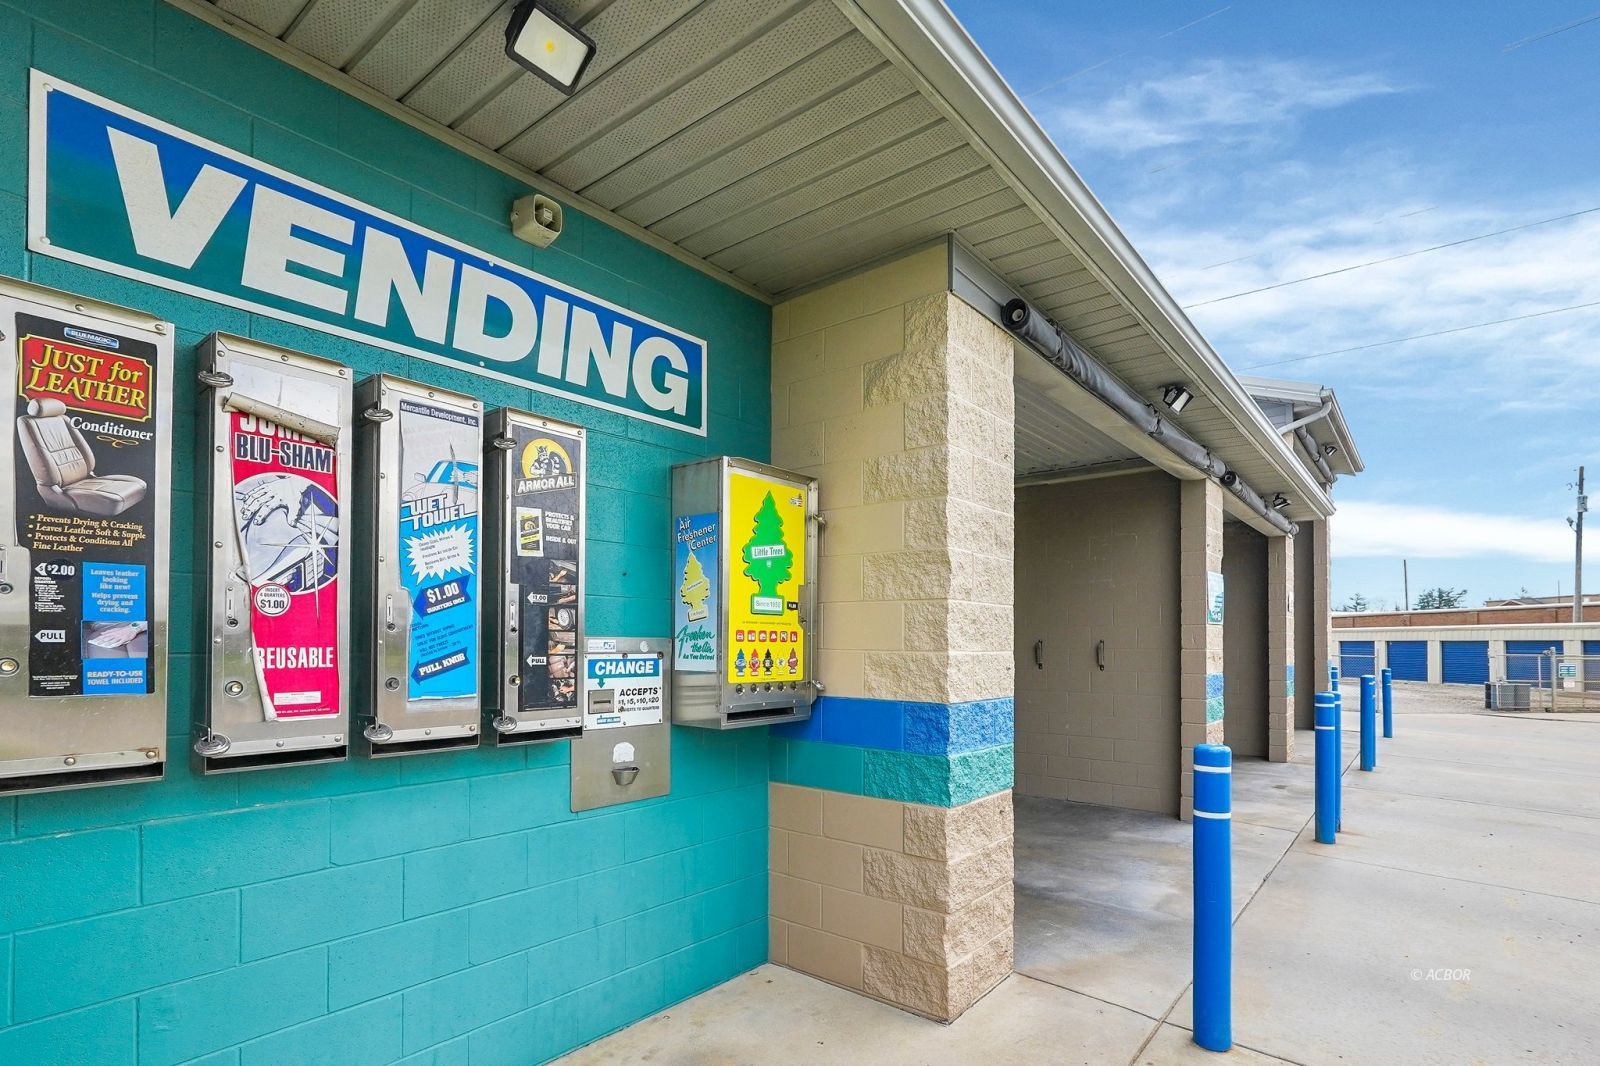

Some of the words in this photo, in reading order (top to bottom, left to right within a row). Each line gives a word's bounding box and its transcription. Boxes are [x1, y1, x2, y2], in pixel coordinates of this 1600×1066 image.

[106, 126, 689, 417] VENDING
[32, 344, 103, 377] JUST
[106, 361, 143, 383] for
[26, 366, 146, 410] LEATHER
[401, 402, 430, 415] Mercantile
[431, 408, 467, 424] Development,
[468, 417, 477, 426] Inc.
[70, 416, 153, 441] Conditioner
[235, 432, 332, 474] BLU-SHAM
[518, 478, 557, 494] ARMOR
[557, 476, 575, 487] ALL
[405, 493, 447, 516] WET
[37, 514, 71, 524] Prevents
[72, 517, 100, 529] Drying
[101, 520, 108, 528] &
[110, 520, 143, 532] Cracking
[405, 504, 468, 531] TOWEL
[679, 518, 691, 530] Air
[34, 532, 68, 542] Protects
[78, 536, 120, 546] Conditions
[36, 523, 62, 532] Leaves
[64, 526, 94, 535] Leather
[95, 528, 111, 536] Soft
[122, 530, 146, 540] Supple
[677, 524, 716, 543] Freshener
[32, 541, 52, 550] Fine
[53, 542, 84, 552] Leather
[690, 535, 716, 550] Center
[754, 547, 768, 556] Little
[769, 546, 783, 555] Trees
[46, 564, 76, 576] $2.00
[426, 582, 460, 604] $1.00
[260, 598, 285, 608] $1.00
[257, 646, 334, 669] REUSABLE
[418, 662, 442, 676] PULL
[442, 652, 466, 668] KNOB
[594, 660, 654, 676] CHANGE
[620, 687, 658, 696] ACCEPTS
